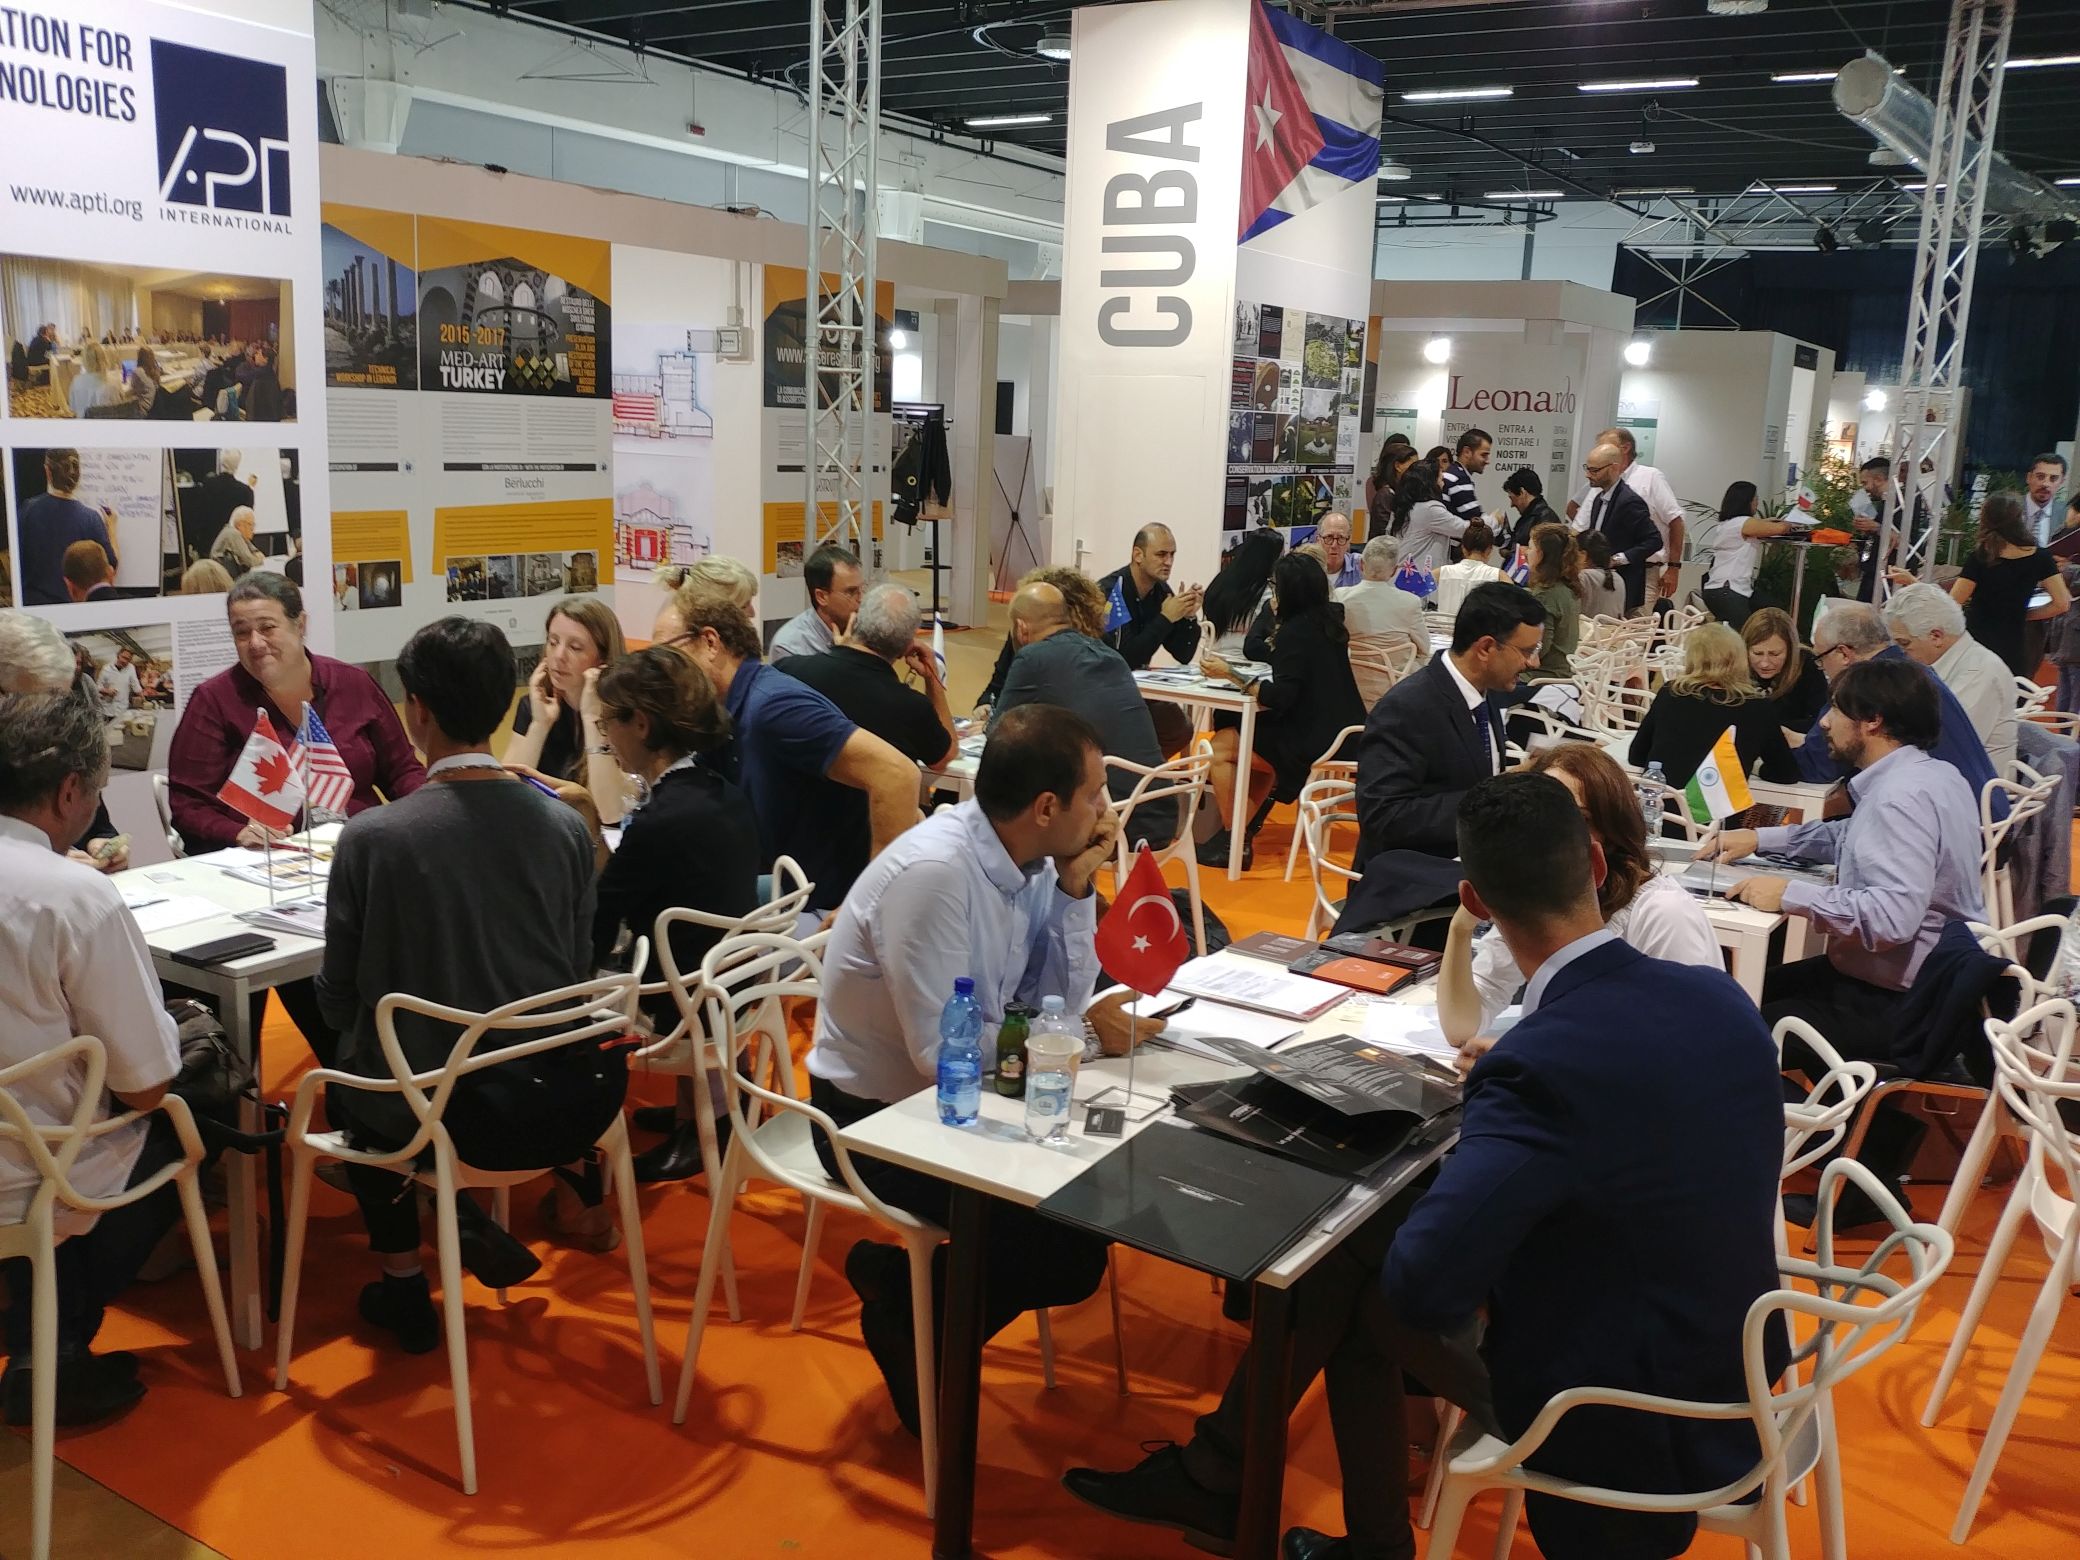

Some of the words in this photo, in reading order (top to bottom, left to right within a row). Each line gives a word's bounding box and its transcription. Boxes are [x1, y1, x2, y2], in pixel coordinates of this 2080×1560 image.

[0, 7, 71, 59] TION
[79, 24, 133, 71] FOR
[0, 61, 136, 122] NOLOGIES
[10, 184, 143, 221] www.apti.org
[160, 208, 292, 235] INTERNATIONAL
[1098, 101, 1203, 347] CUBA
[441, 350, 506, 369] MED-ART
[440, 366, 506, 390] TURKEY
[1448, 376, 1576, 414] Leonardo
[1497, 438, 1535, 447] VISITARE
[1498, 424, 1526, 434] ENTRA
[1527, 425, 1534, 434] A
[1496, 450, 1528, 459] NOSTRI
